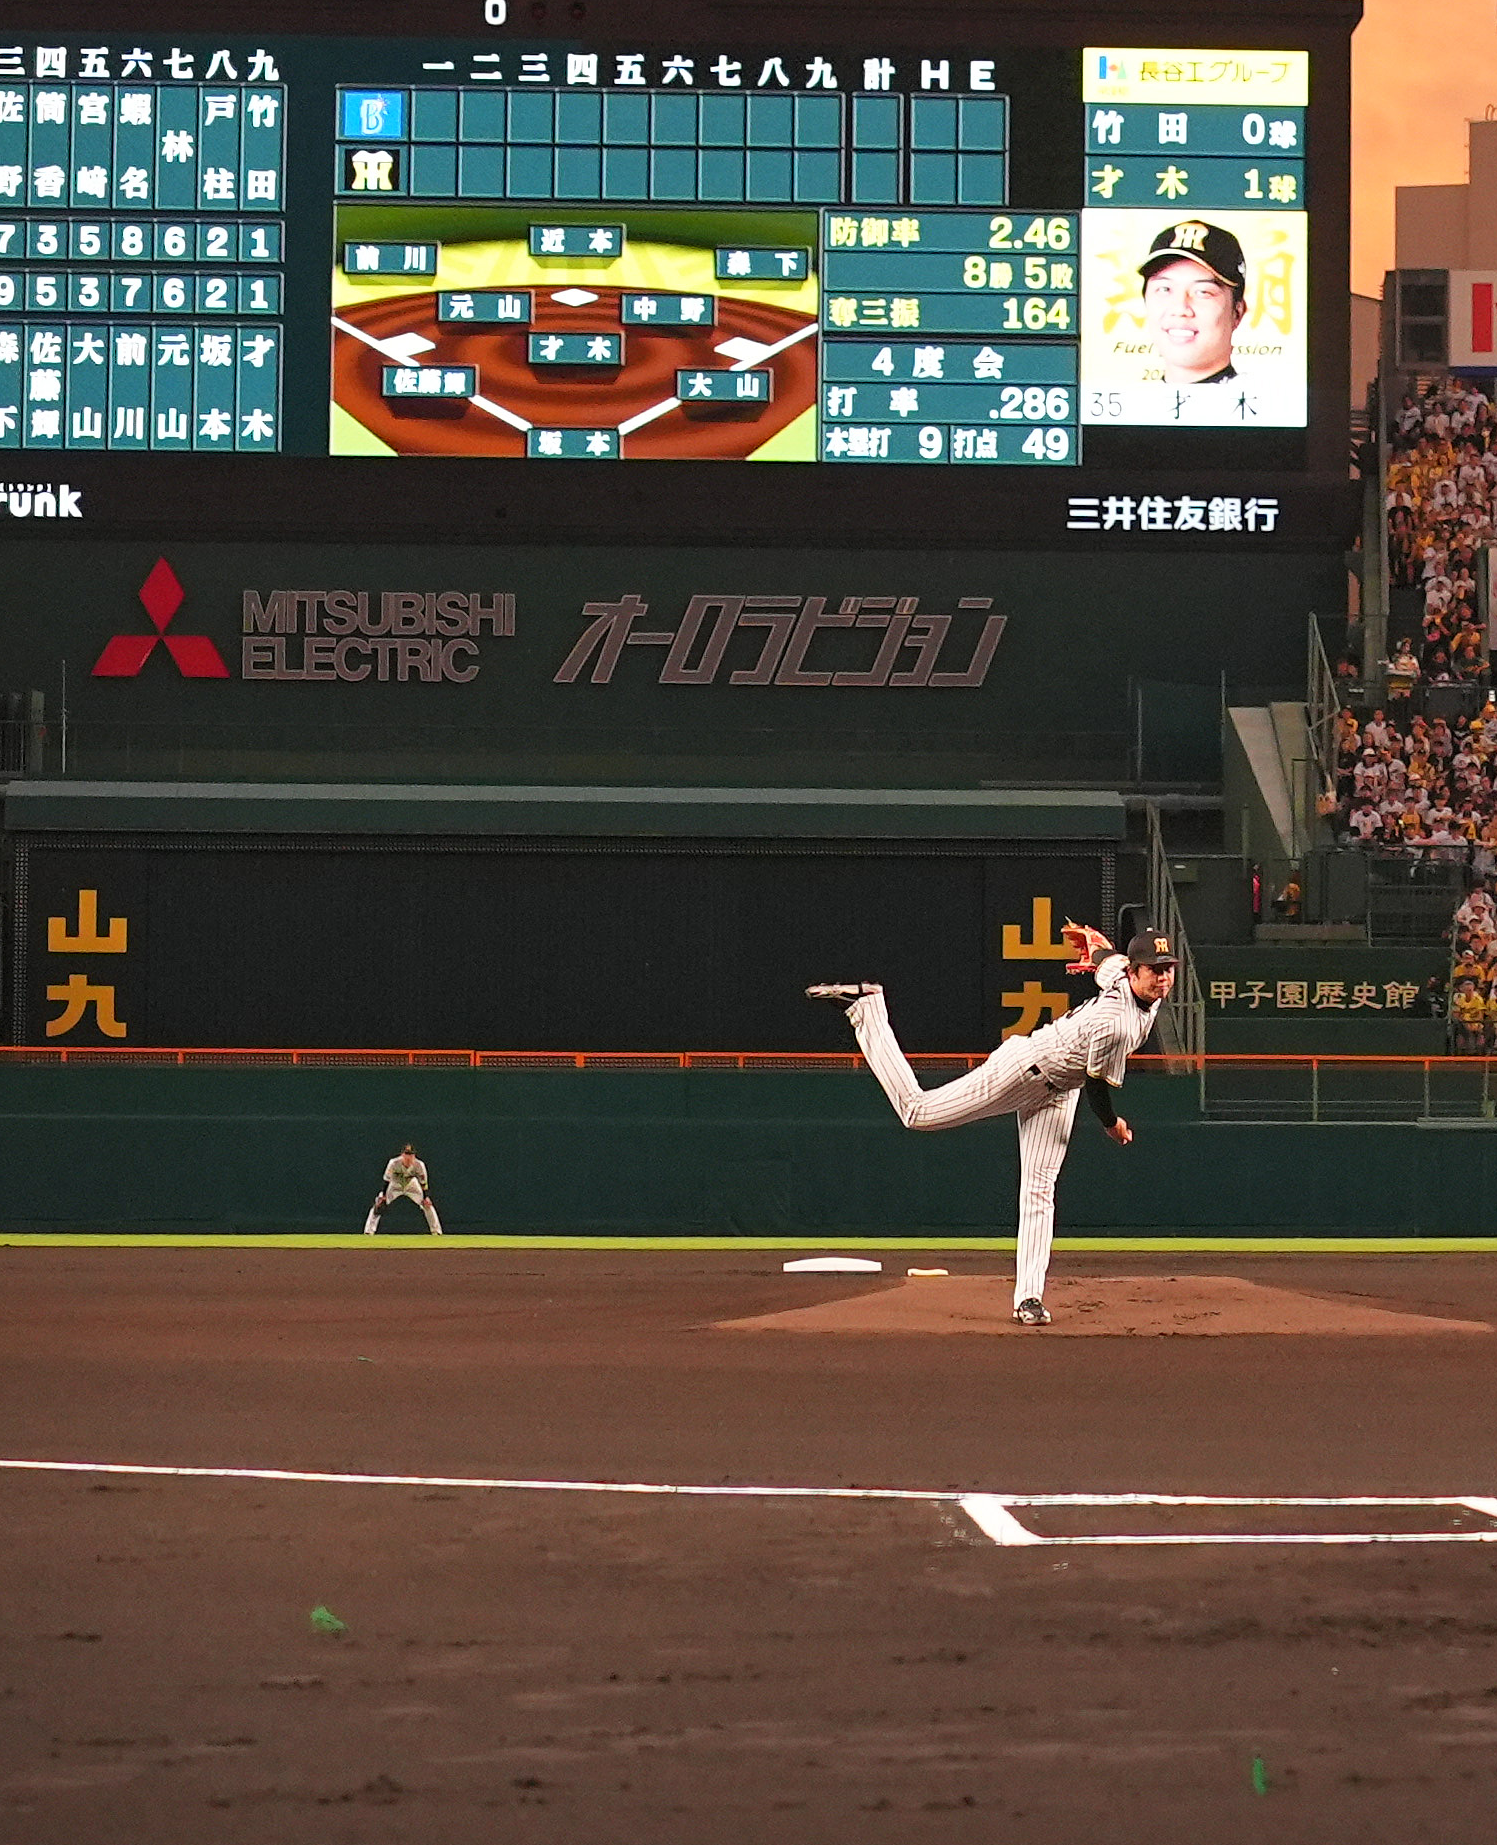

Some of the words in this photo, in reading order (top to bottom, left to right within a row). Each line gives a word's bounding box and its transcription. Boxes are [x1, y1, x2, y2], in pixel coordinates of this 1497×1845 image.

[35, 46, 67, 79] 四
[78, 46, 110, 78] 五
[121, 47, 153, 78] 六
[162, 47, 195, 79] 七
[205, 49, 238, 80] 八
[247, 48, 280, 82] 九
[422, 61, 455, 70] 一
[470, 53, 503, 80] 二
[518, 52, 550, 82] 三
[566, 53, 598, 86] 四
[613, 53, 646, 85] 五
[661, 54, 694, 85] 六
[709, 54, 742, 87] 七
[757, 56, 790, 87] 八
[805, 56, 838, 89] 九
[863, 57, 896, 91] 計
[920, 59, 950, 90] H
[970, 60, 996, 91] E
[1092, 109, 1188, 145] 竹田
[161, 130, 194, 163] 林
[203, 94, 237, 200] 戸柱
[246, 95, 279, 201] 竹田
[1091, 164, 1188, 200] 才木
[36, 224, 58, 255] 3
[79, 225, 101, 256] 5
[121, 225, 144, 256] 8
[163, 225, 186, 257] 6
[206, 226, 229, 257] 2
[250, 228, 270, 258] 1
[541, 228, 613, 254] 近本
[830, 217, 920, 248] 防御率
[989, 216, 1071, 250] 2.46
[356, 245, 427, 272] 前川
[727, 252, 798, 278] 森下
[35, 276, 58, 307] 5
[78, 277, 100, 307] 3
[121, 277, 143, 307] 7
[162, 277, 185, 308] 6
[205, 278, 228, 308] 2
[250, 279, 269, 309] 1
[449, 295, 521, 320] 元山
[634, 298, 706, 322] 中野
[828, 297, 920, 328] 奪三振
[1002, 297, 1071, 330] 164
[539, 336, 612, 361] 才木
[871, 346, 895, 377] 4
[912, 345, 1004, 380] 度会
[72, 332, 105, 439] 大山
[113, 332, 148, 440] 前川
[157, 333, 190, 440] 元山
[198, 334, 232, 441] 坂本
[241, 334, 275, 442] 才木
[688, 373, 760, 398] 大山
[827, 386, 919, 418] 打率
[989, 386, 1070, 421] .286
[1090, 392, 1123, 419] 35
[538, 432, 611, 457] 坂本
[825, 426, 892, 458] 本塁打
[918, 425, 943, 459] 9
[954, 427, 998, 459] 打点
[1021, 427, 1070, 460] 49
[1066, 497, 1279, 532] 三井住友銀行
[242, 590, 516, 635] MITSUBISHI
[553, 594, 1008, 688] オーロラビジョン
[242, 638, 480, 683] ELECTRIC
[46, 889, 129, 1039] 山九
[1210, 980, 1420, 1012] 甲子園歴史館
